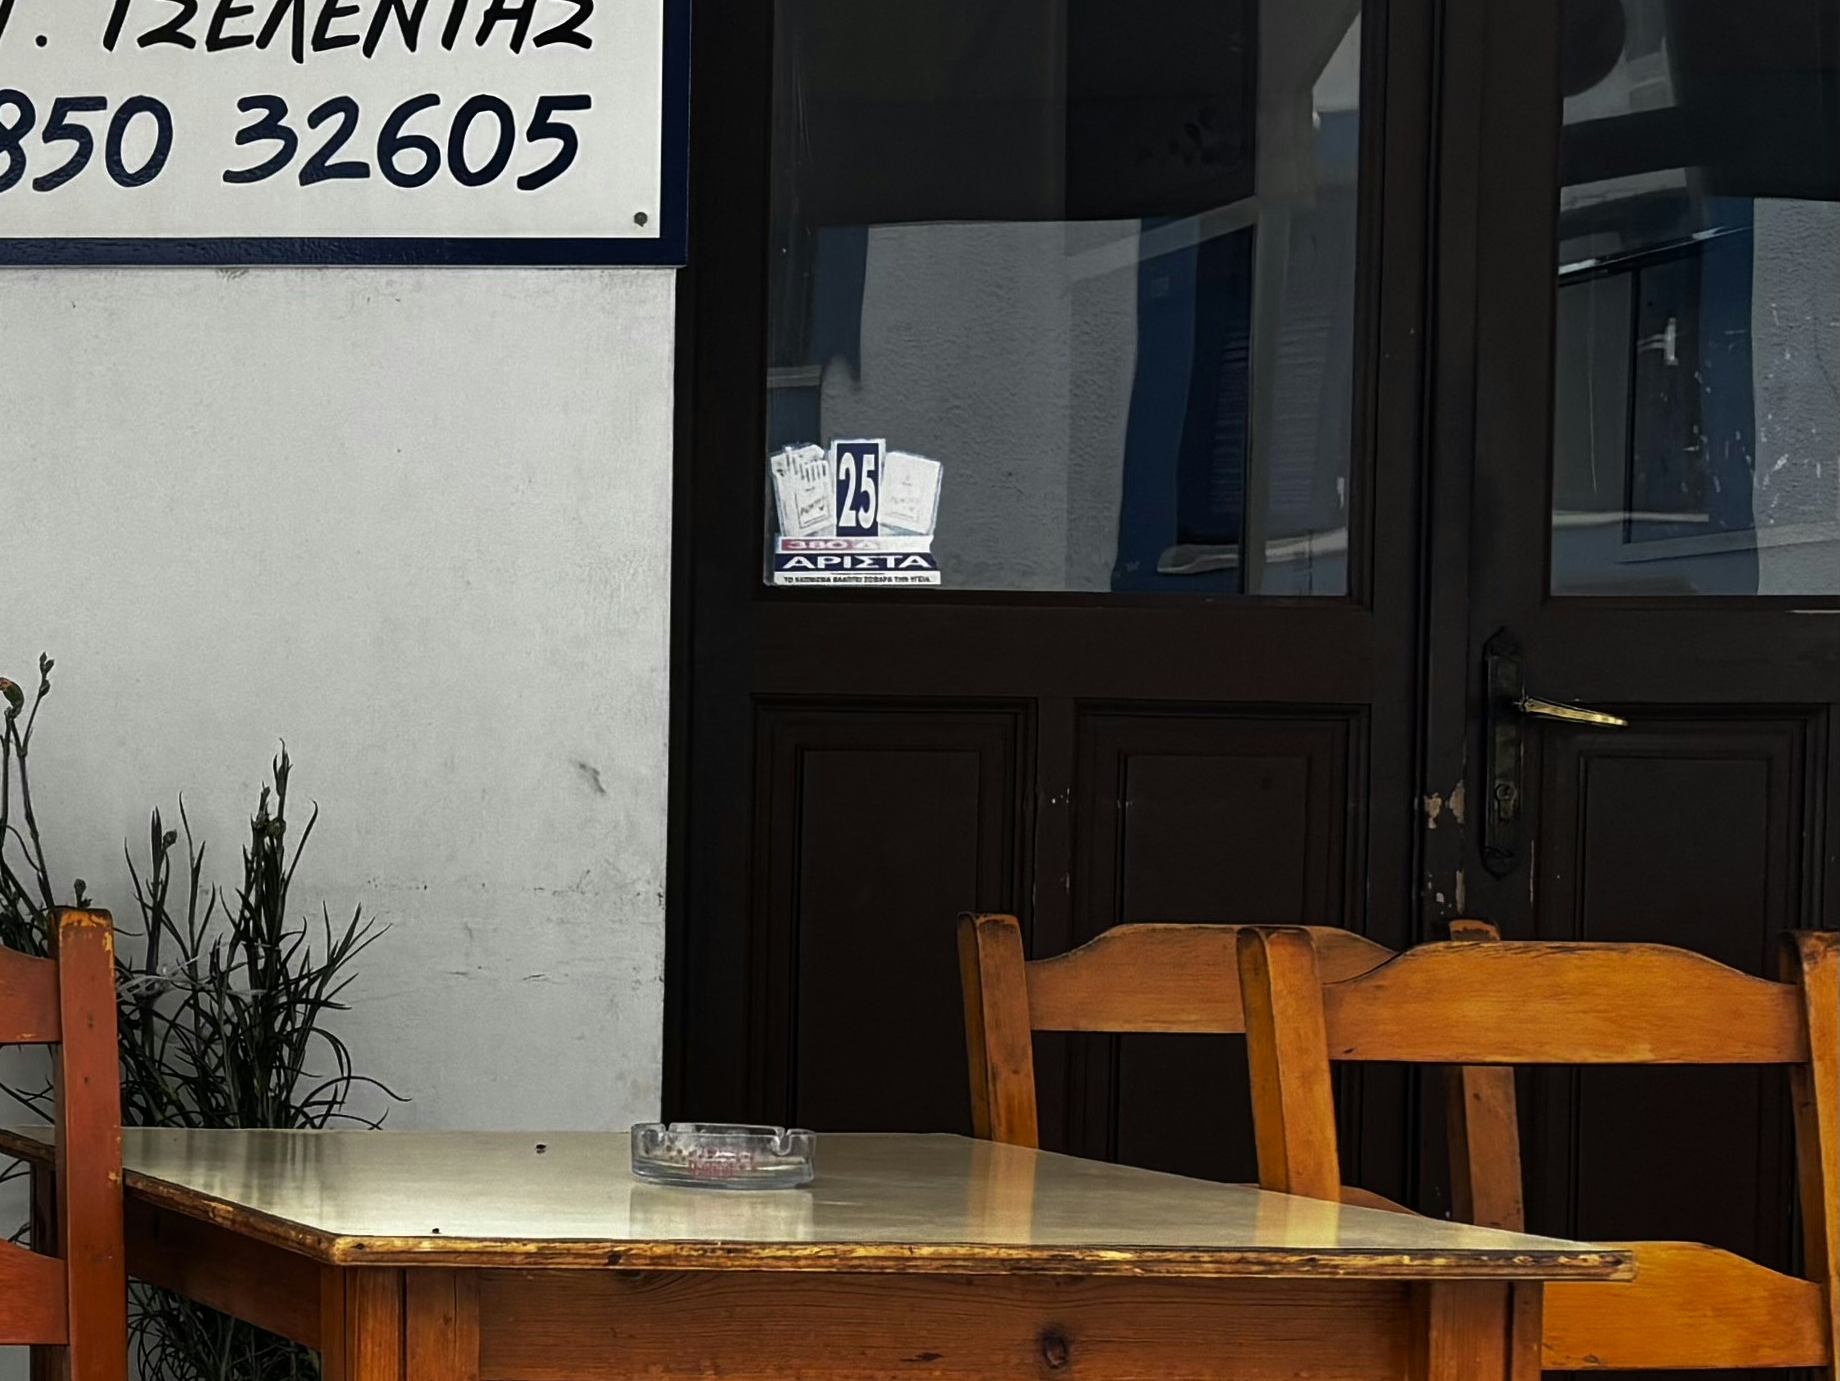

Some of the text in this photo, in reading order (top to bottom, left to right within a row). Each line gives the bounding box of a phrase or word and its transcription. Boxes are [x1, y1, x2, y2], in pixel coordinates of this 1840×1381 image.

[221, 93, 593, 192] 32605
[838, 451, 878, 530] 25
[782, 554, 932, 570] ΑΡΙΣΤΑ
